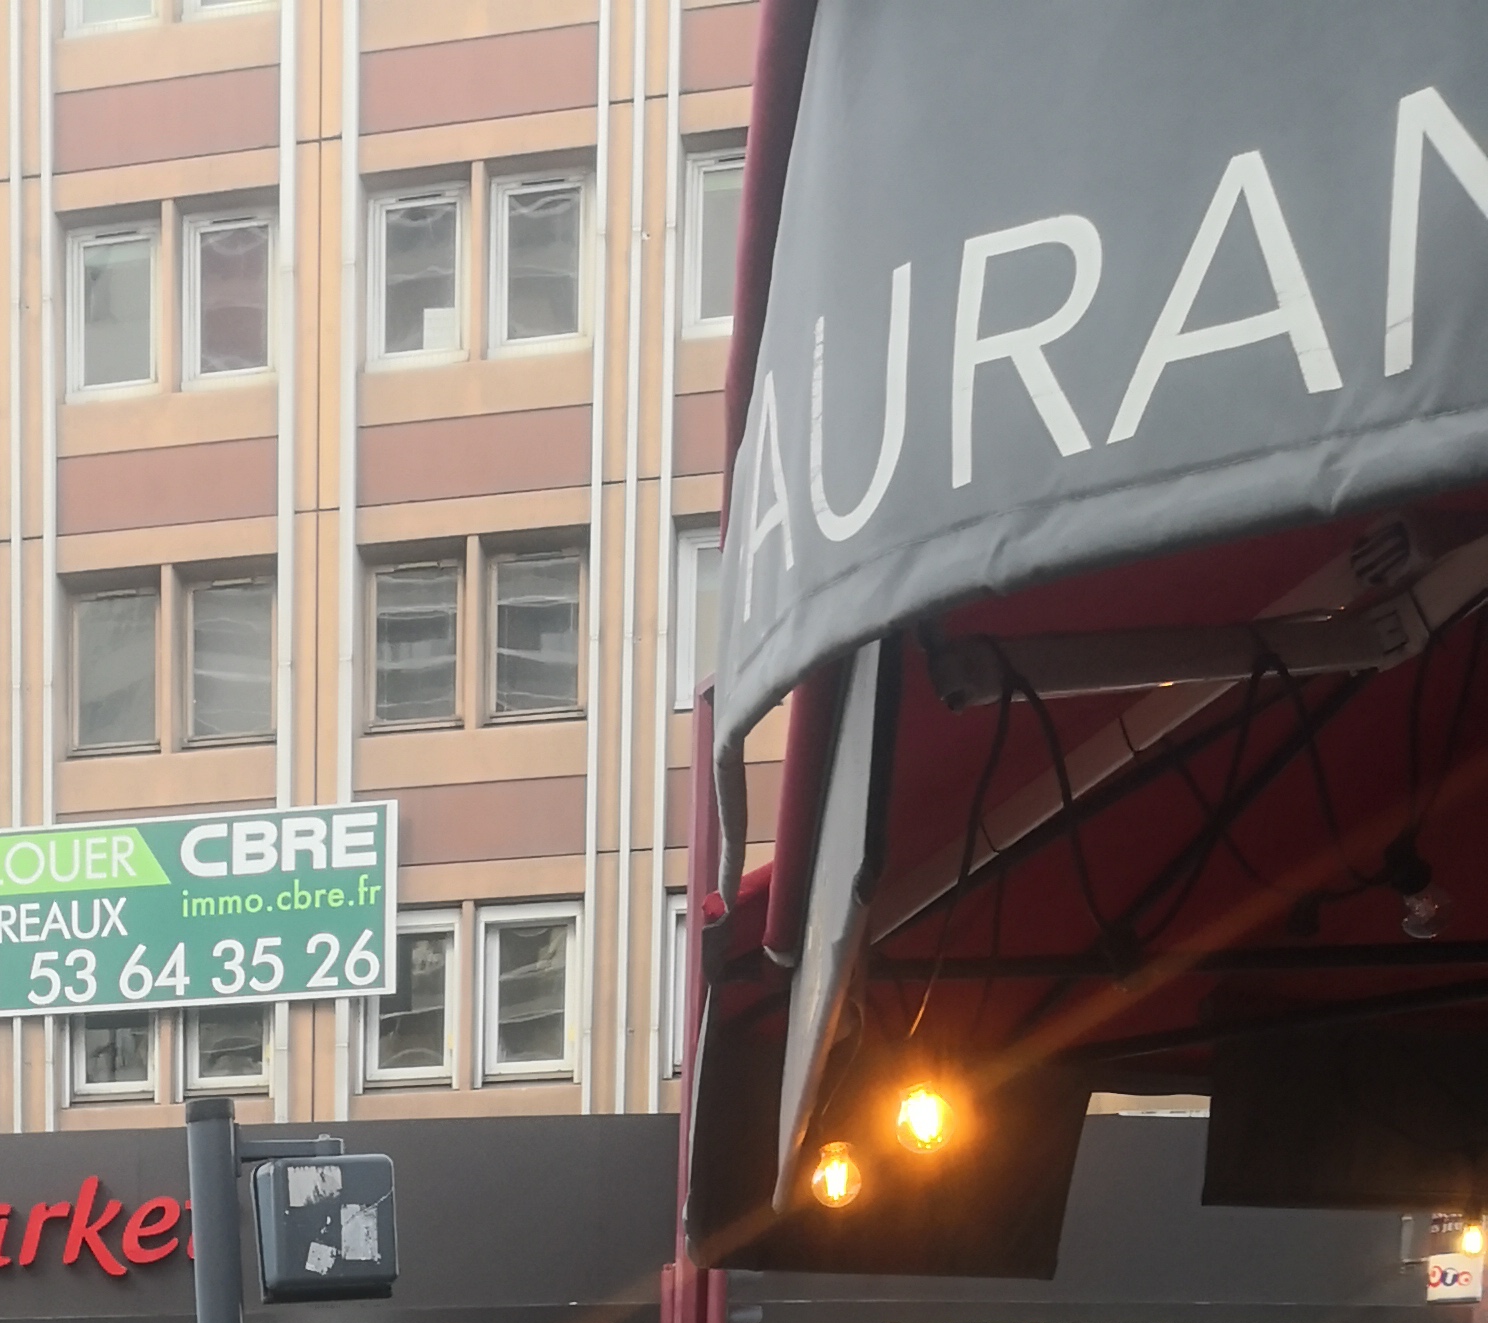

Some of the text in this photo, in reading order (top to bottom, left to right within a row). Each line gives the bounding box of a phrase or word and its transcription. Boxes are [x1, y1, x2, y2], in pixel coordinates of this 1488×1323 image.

[180, 812, 378, 877] CBRE
[182, 874, 382, 918] immo.cbre.fr
[27, 949, 98, 1006] 53
[118, 942, 191, 1000] 64
[211, 936, 285, 995] 35
[306, 928, 381, 989] 26
